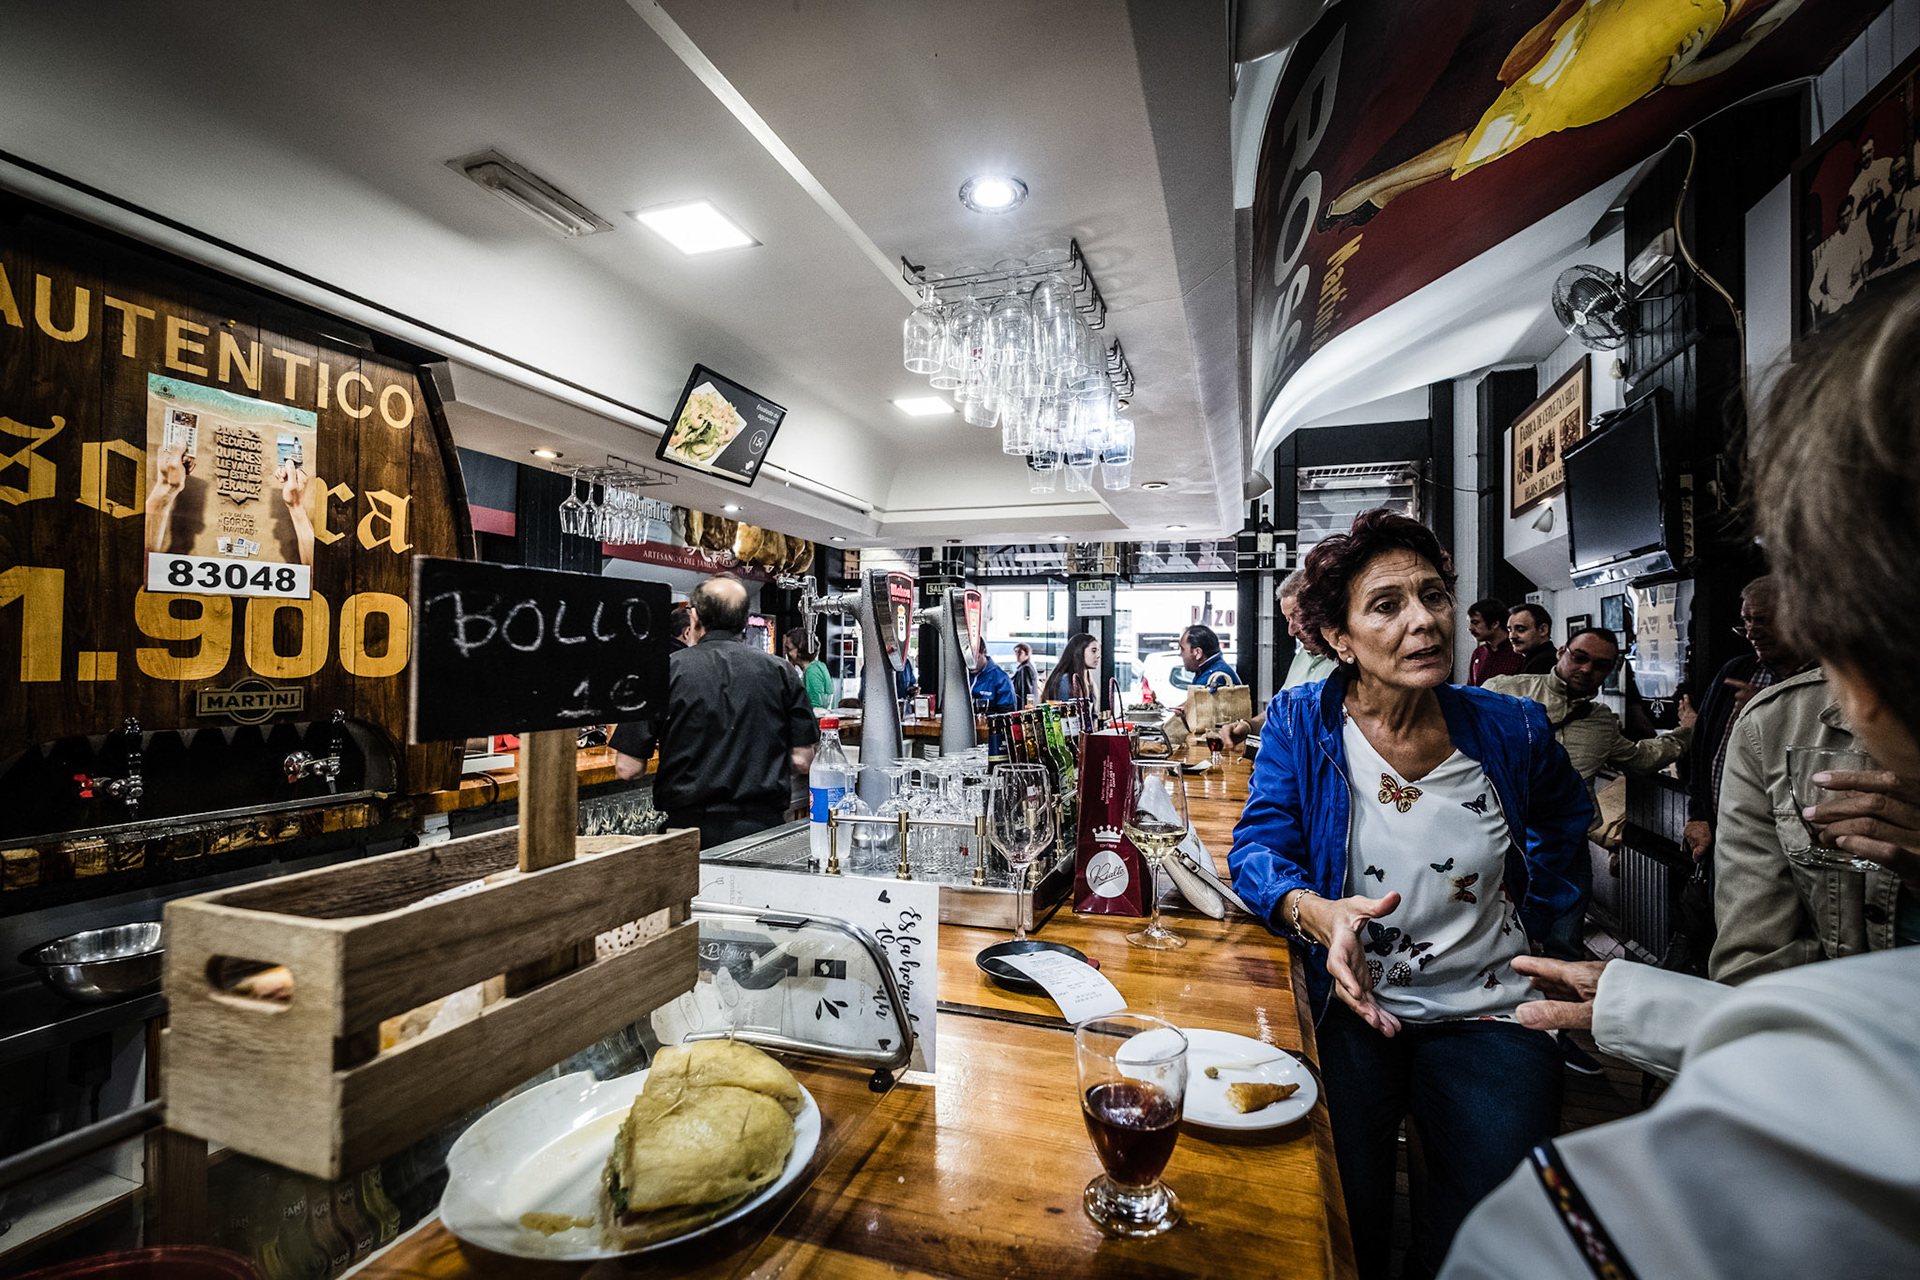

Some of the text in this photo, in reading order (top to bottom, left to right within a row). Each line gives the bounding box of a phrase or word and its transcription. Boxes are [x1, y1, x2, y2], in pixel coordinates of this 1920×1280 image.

[1312, 233, 1363, 340] Martini
[216, 434, 262, 452] RECUERDO
[216, 445, 262, 465] QUIERES
[216, 457, 261, 474] LLEVARTE
[230, 470, 249, 480] ESTE
[216, 478, 261, 496] VERANO?
[223, 516, 255, 528] GORDO
[642, 549, 683, 564] ARTESANOS
[683, 556, 695, 567] DEL
[168, 559, 297, 592] 83048
[890, 583, 911, 599] Mahou
[1079, 582, 1108, 591] SALIDA
[0, 565, 413, 682] 1.900
[206, 692, 297, 710] MARTINI
[1089, 862, 1126, 887] Rialto
[899, 906, 922, 933] Es
[896, 936, 922, 958] la
[898, 961, 922, 1005] hora
[282, 1195, 307, 1221] FANT
